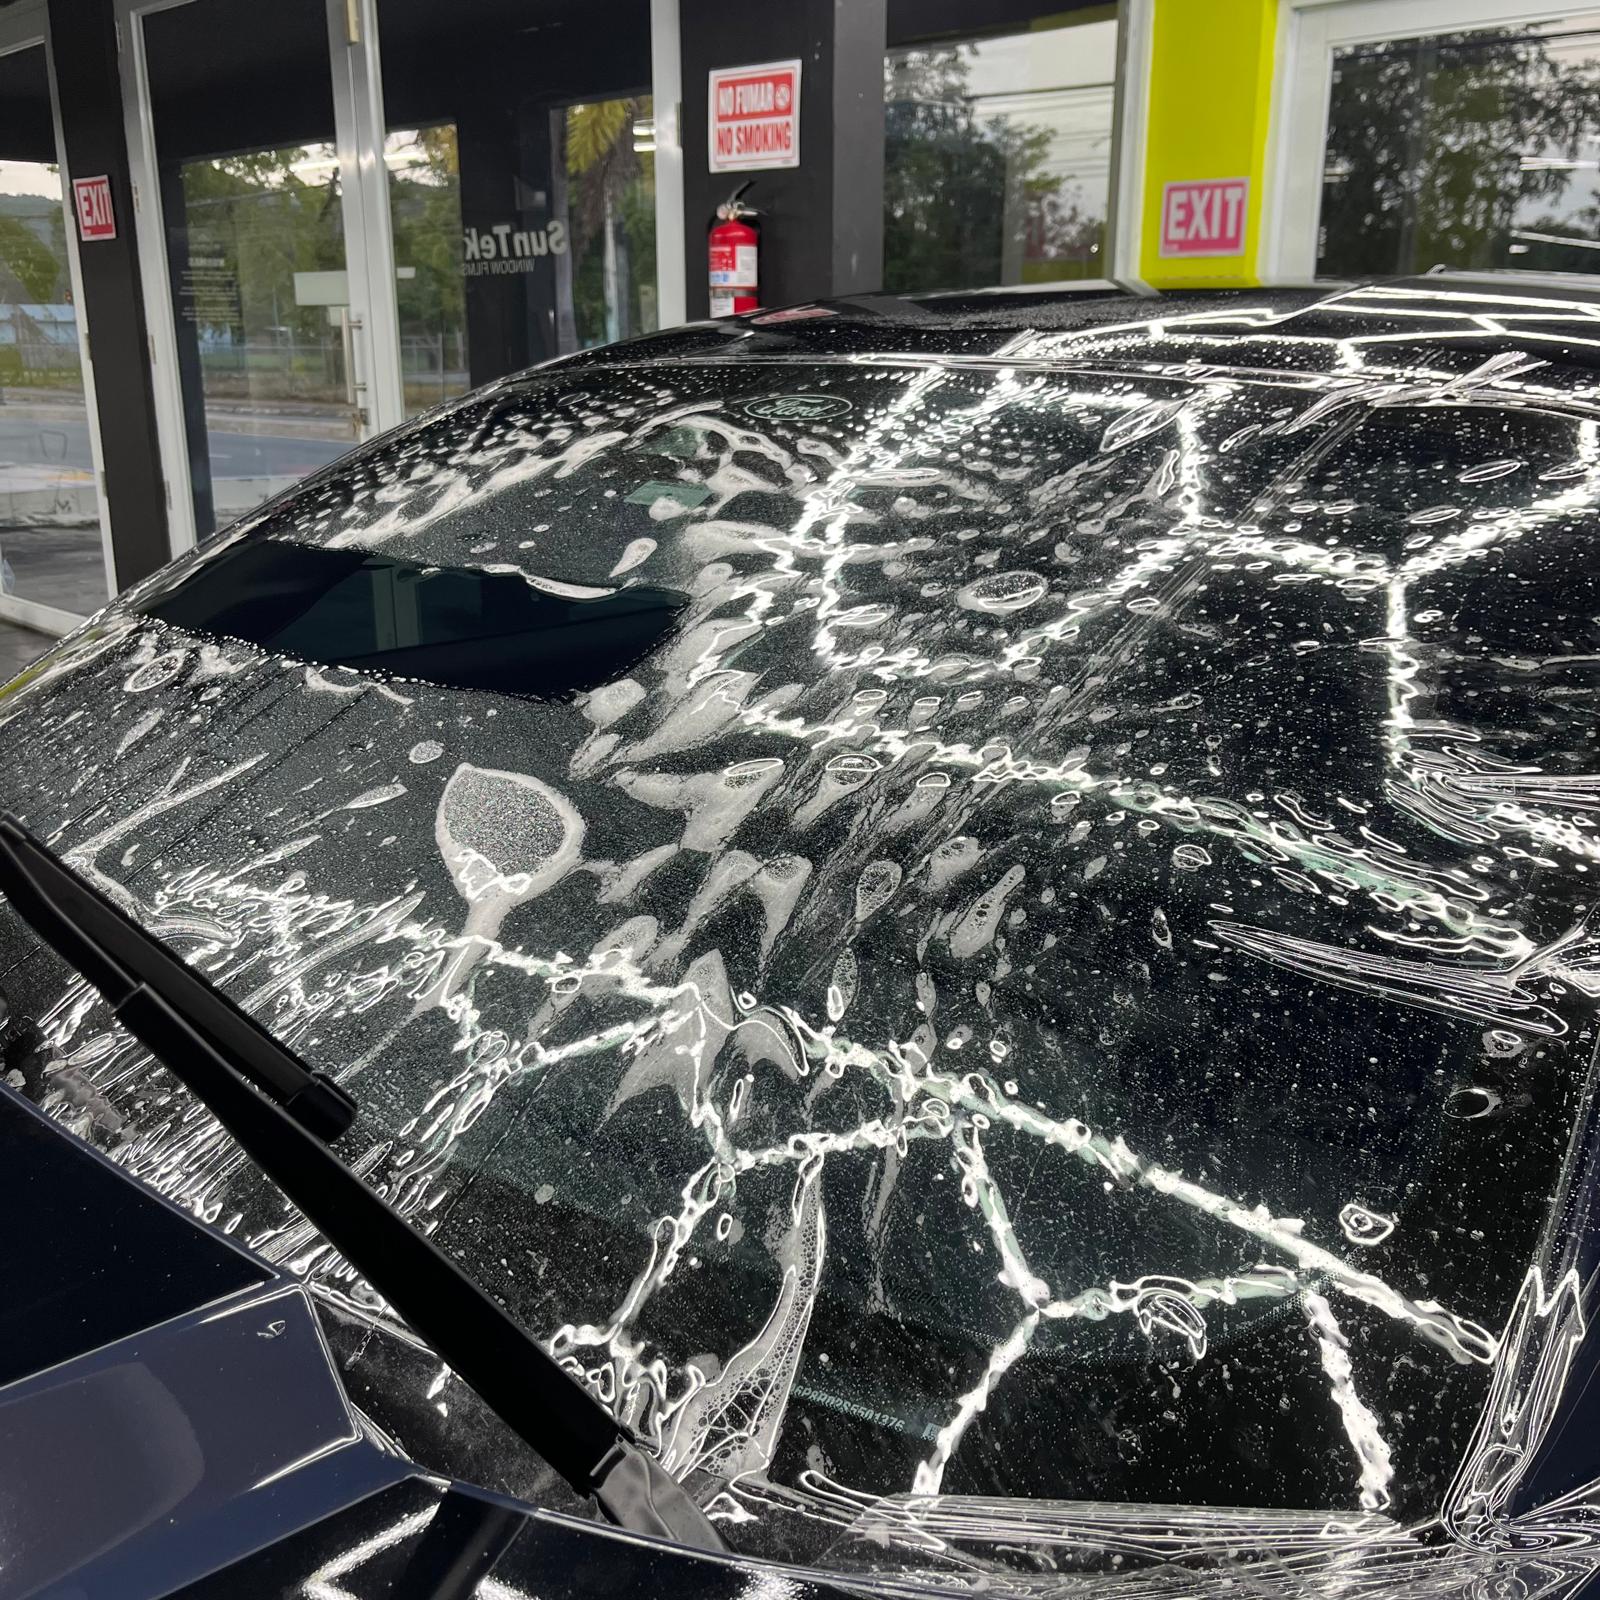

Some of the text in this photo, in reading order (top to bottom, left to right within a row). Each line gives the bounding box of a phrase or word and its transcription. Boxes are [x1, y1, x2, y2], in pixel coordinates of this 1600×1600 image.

[719, 82, 775, 116] NO FUMAR
[718, 121, 791, 155] NO SMOKING
[78, 183, 112, 226] EXIT
[1167, 187, 1243, 240] EXIT
[755, 397, 836, 417] Ford
